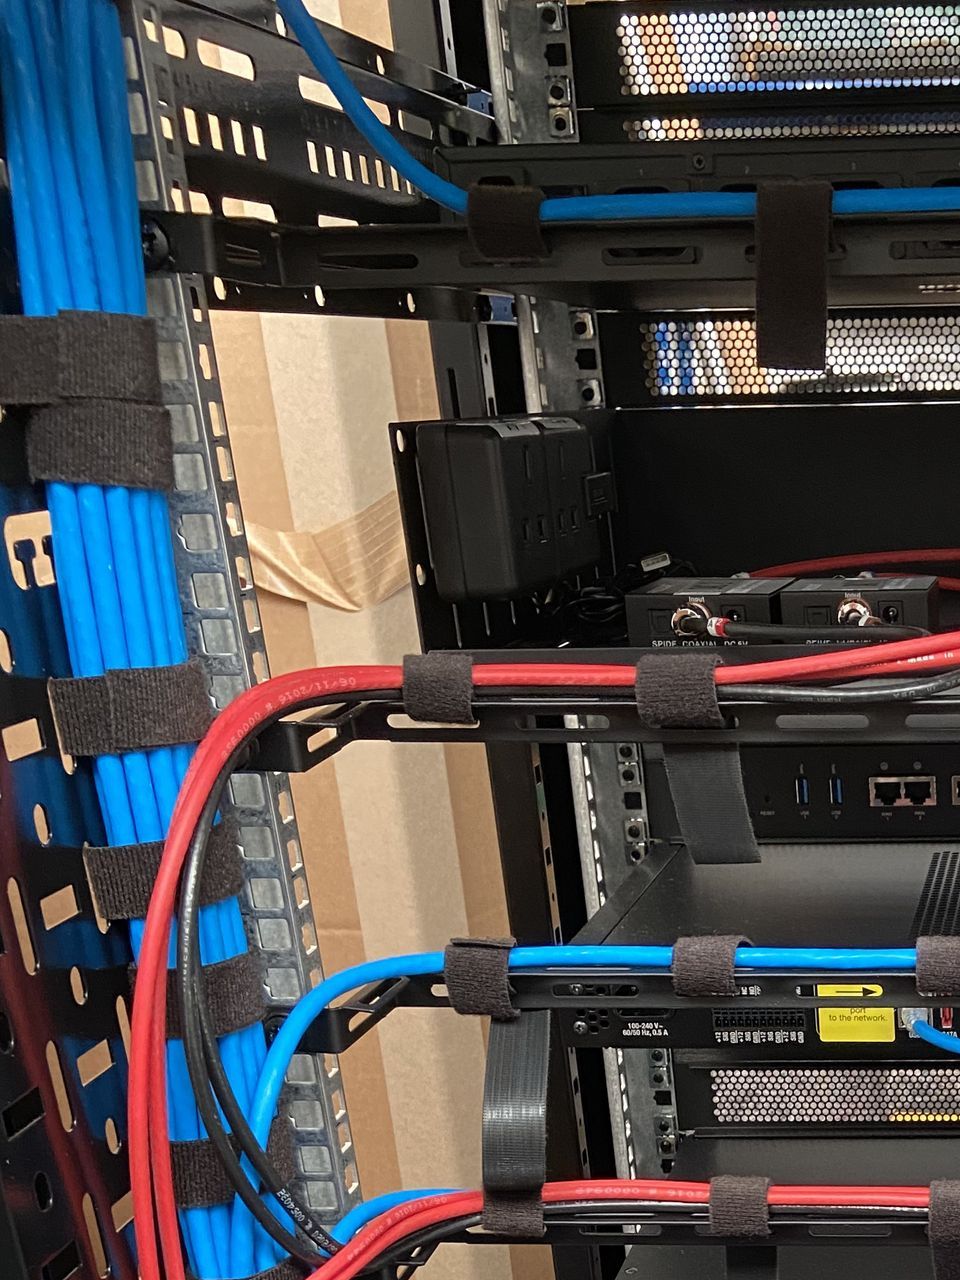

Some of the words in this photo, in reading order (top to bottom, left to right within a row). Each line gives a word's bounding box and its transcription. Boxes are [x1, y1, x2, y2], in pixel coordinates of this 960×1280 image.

[850, 1007, 867, 1015] port
[829, 1013, 838, 1022] to
[839, 1013, 852, 1022] the
[853, 1013, 886, 1022] network.
